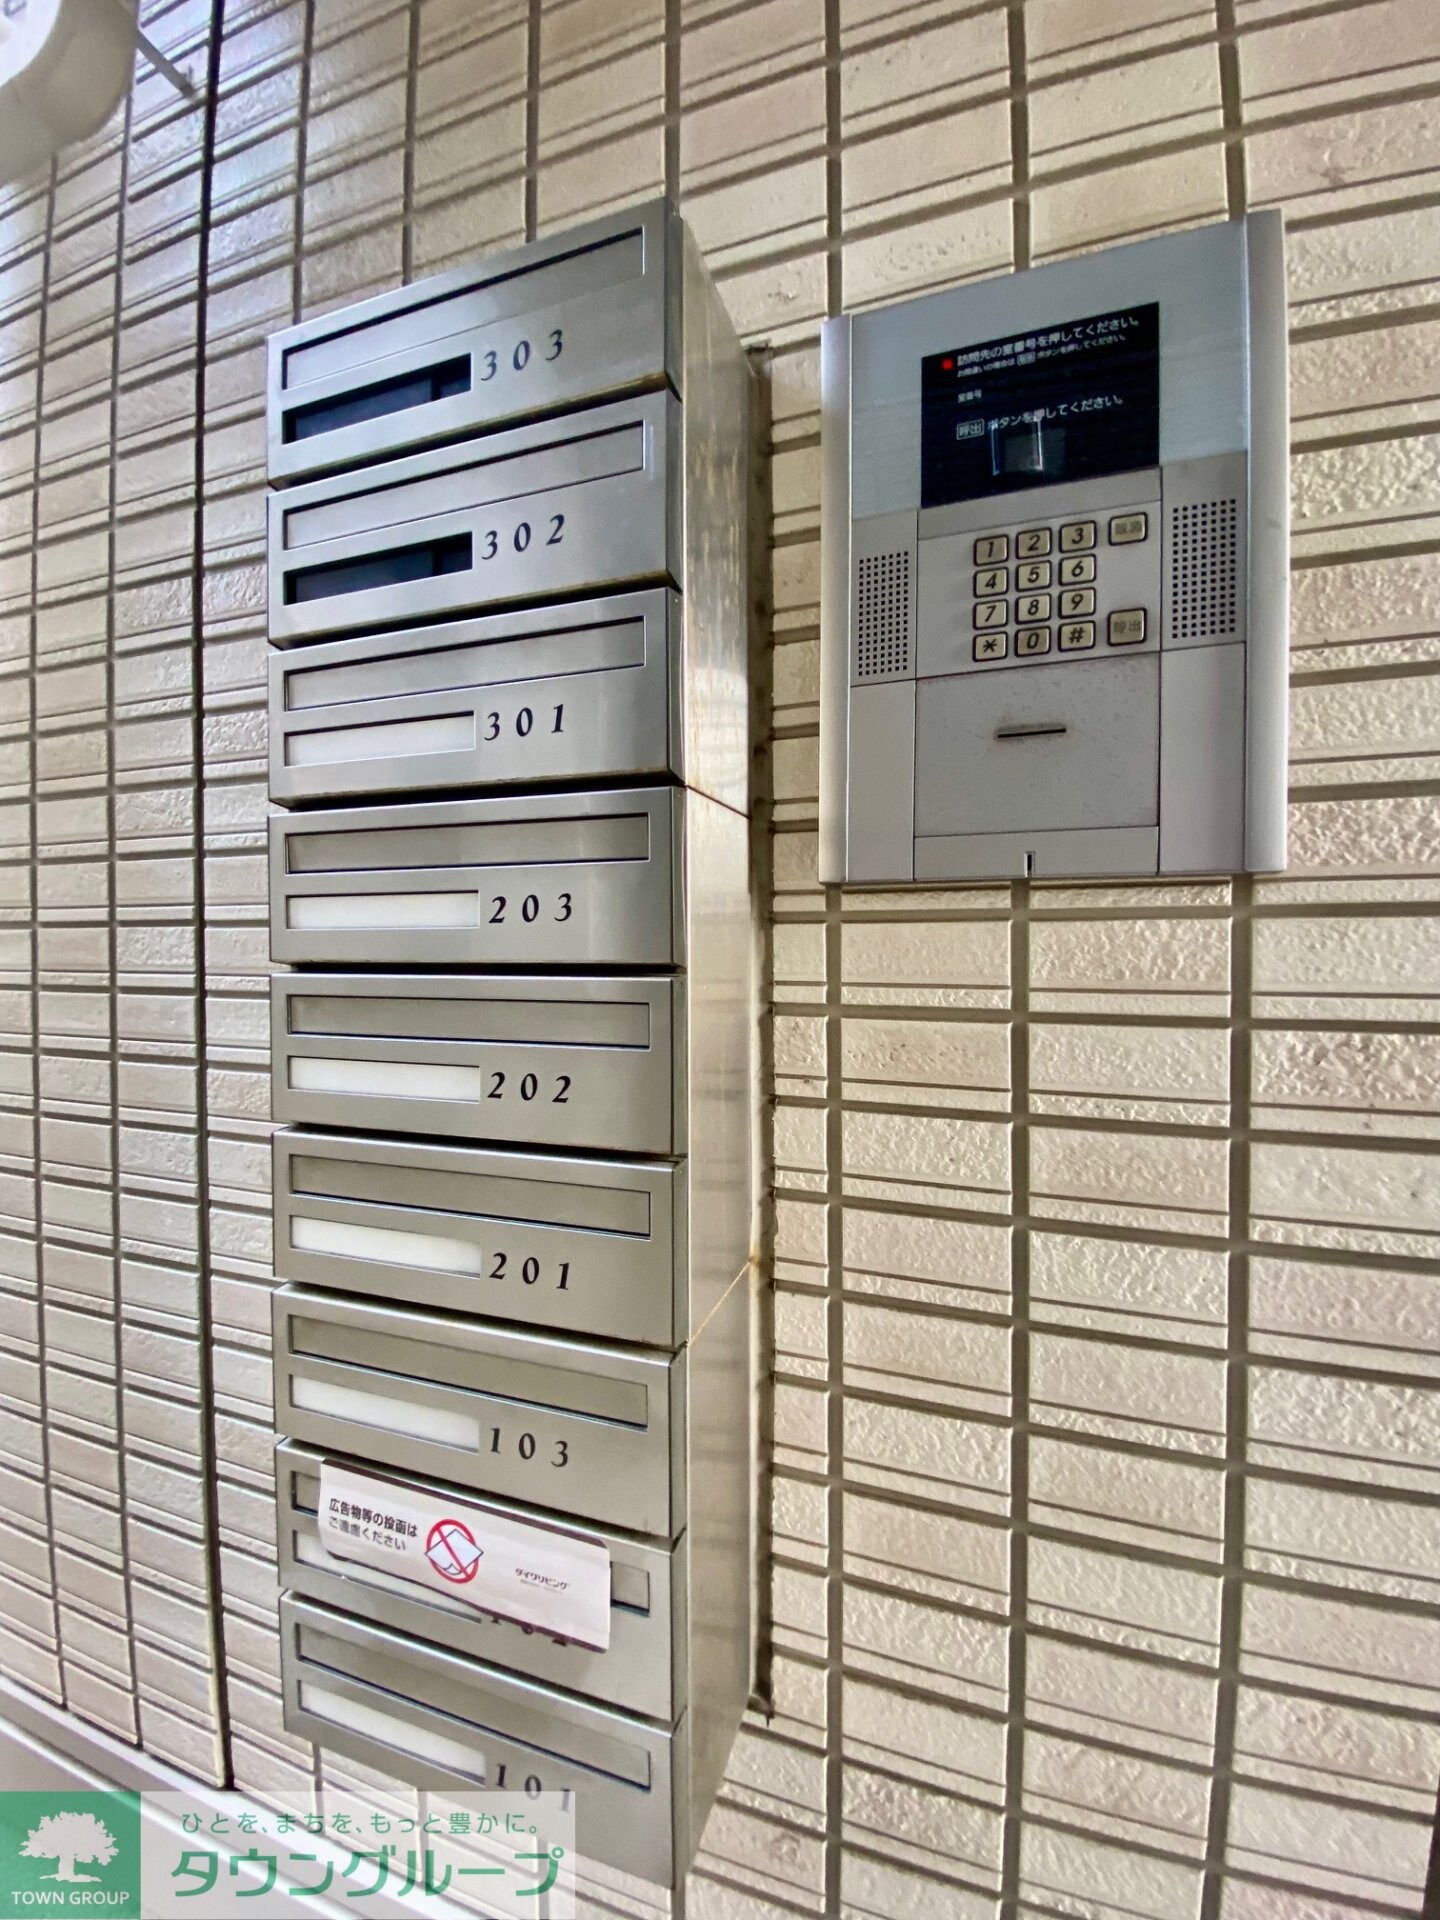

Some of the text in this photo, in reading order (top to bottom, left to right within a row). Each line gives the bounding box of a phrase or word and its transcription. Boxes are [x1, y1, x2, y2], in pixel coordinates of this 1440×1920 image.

[481, 329, 563, 381] 303
[481, 514, 565, 560] 302
[987, 528, 1084, 558] 1 2 3
[985, 560, 1084, 589] 4 5 6
[985, 593, 1084, 622] 7 8 9
[1027, 632, 1039, 649] 0
[1069, 627, 1085, 643] #
[483, 704, 564, 741] 301
[488, 892, 573, 924] 203
[487, 1072, 571, 1104] 202
[489, 1252, 571, 1291] 201
[489, 1427, 569, 1468] 103
[328, 1516, 406, 1551] ご遠慮ください
[494, 1763, 571, 1814] 101
